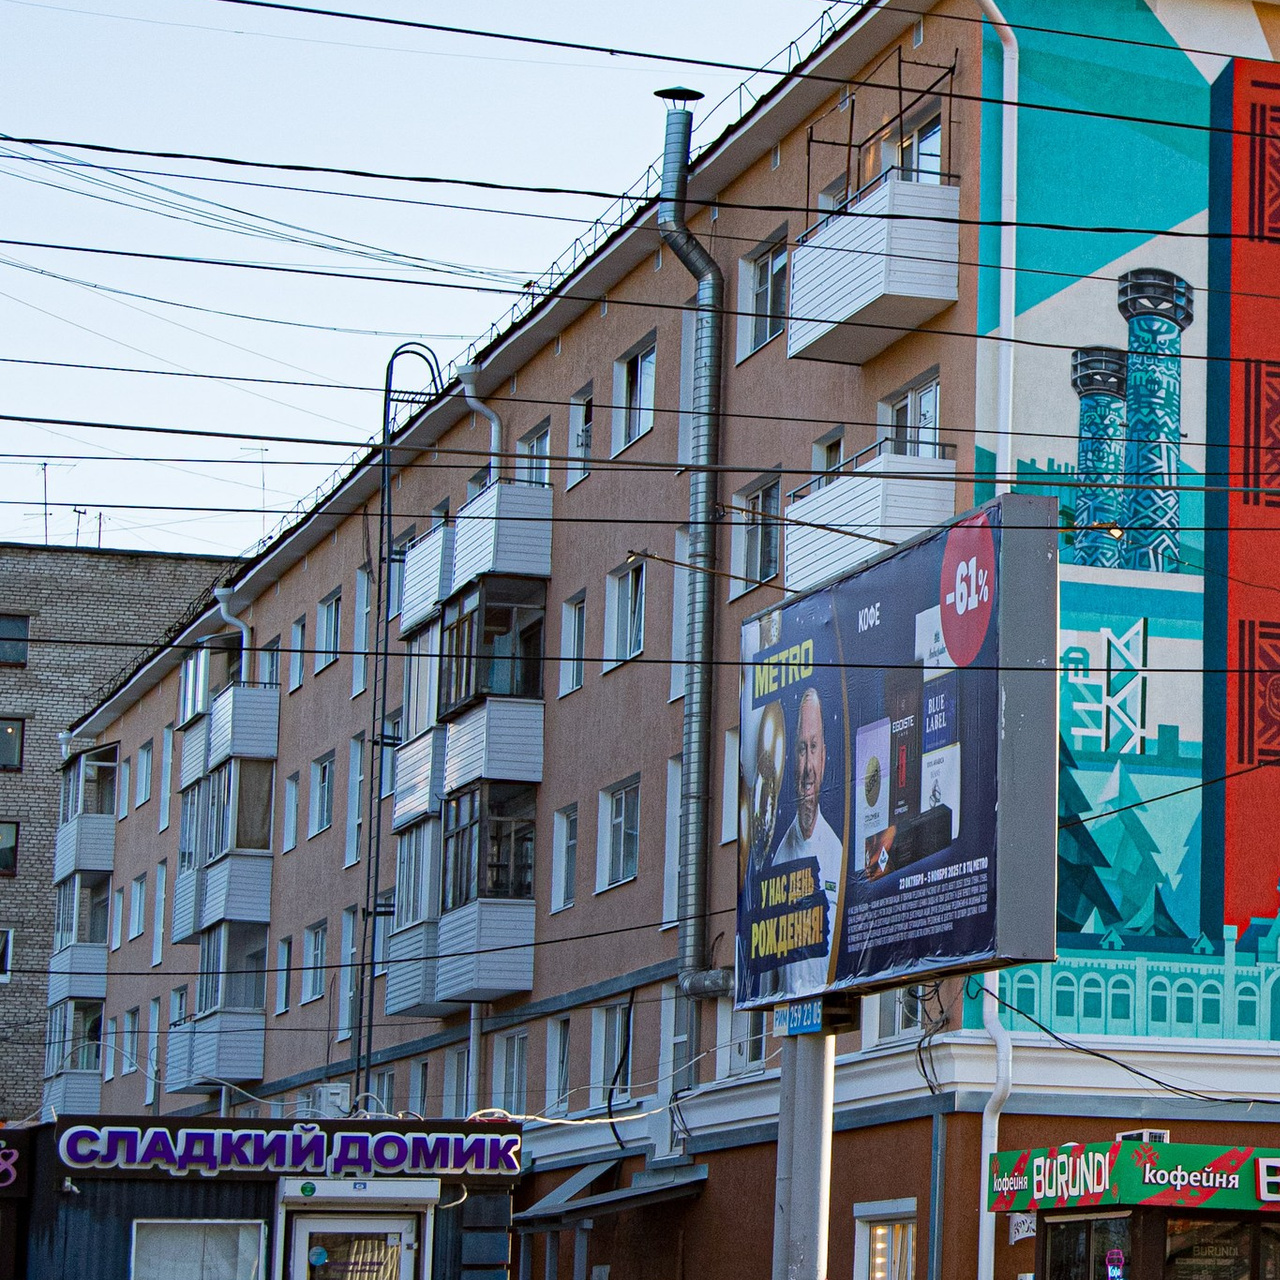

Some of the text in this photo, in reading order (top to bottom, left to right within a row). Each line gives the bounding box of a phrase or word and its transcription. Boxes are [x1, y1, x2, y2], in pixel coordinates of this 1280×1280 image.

[945, 556, 989, 616] -61%
[858, 602, 881, 634] КОФЕ
[754, 638, 814, 699] METRO
[926, 712, 947, 733] LABEL
[928, 693, 945, 715] BLUE
[761, 867, 815, 909] У НАС ДЕНЬ
[751, 905, 824, 959] РОЖДЕНИЯ!
[62, 1124, 326, 1173] СЛАДКИЙ
[331, 1133, 520, 1175] ДОМИК
[992, 1151, 1110, 1201] кофейня BURUNDI
[1143, 1162, 1240, 1190] кофейня
